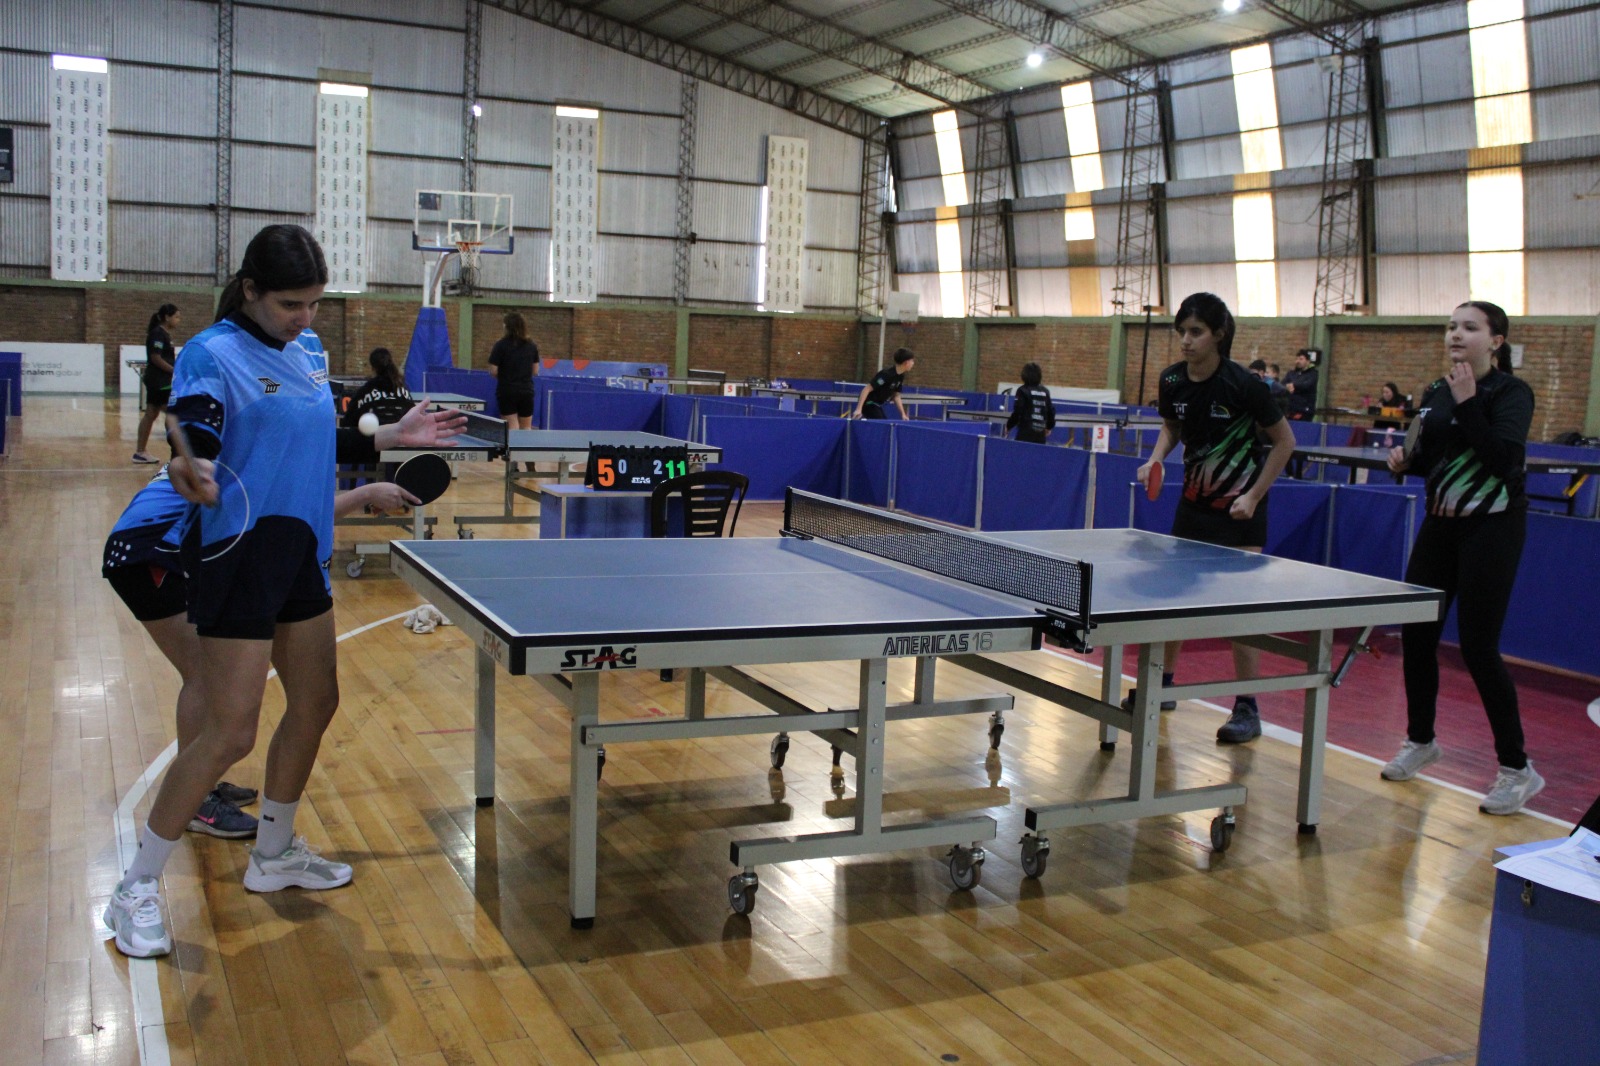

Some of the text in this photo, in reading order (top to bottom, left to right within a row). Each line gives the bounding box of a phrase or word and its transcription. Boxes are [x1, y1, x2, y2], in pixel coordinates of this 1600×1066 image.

[32, 361, 62, 369] Verdad
[1097, 427, 1104, 440] 3
[687, 453, 708, 462] TAG
[597, 458, 686, 487] 5 0 2 11
[631, 476, 651, 484] STAG
[483, 630, 502, 661] STAG
[882, 631, 993, 656] AMERICAS 16
[560, 645, 637, 671] STAG
